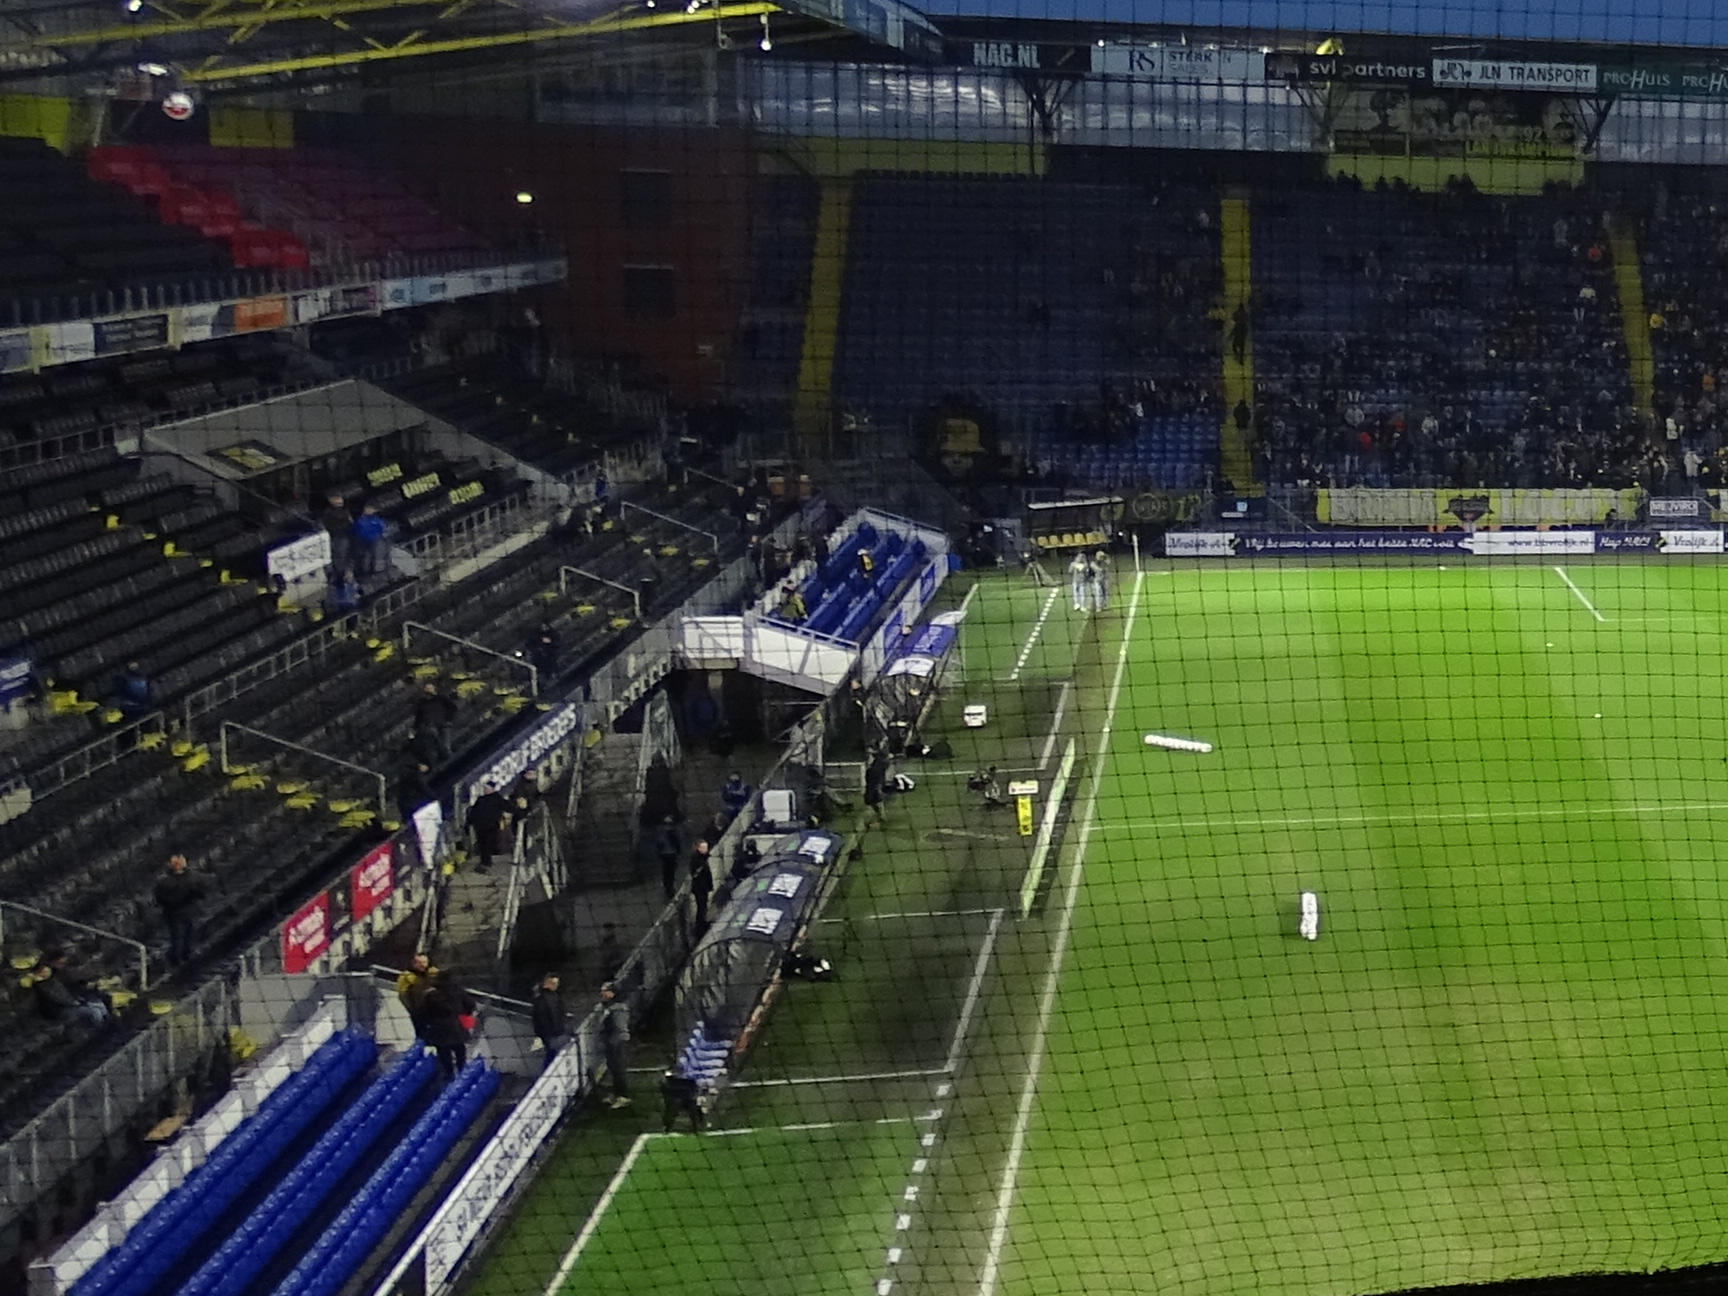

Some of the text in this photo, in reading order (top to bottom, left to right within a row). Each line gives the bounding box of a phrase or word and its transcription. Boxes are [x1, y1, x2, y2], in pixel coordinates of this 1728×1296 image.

[972, 41, 1041, 69] NAC.NL
[1478, 65, 1591, 84] JLN TRANSPORT
